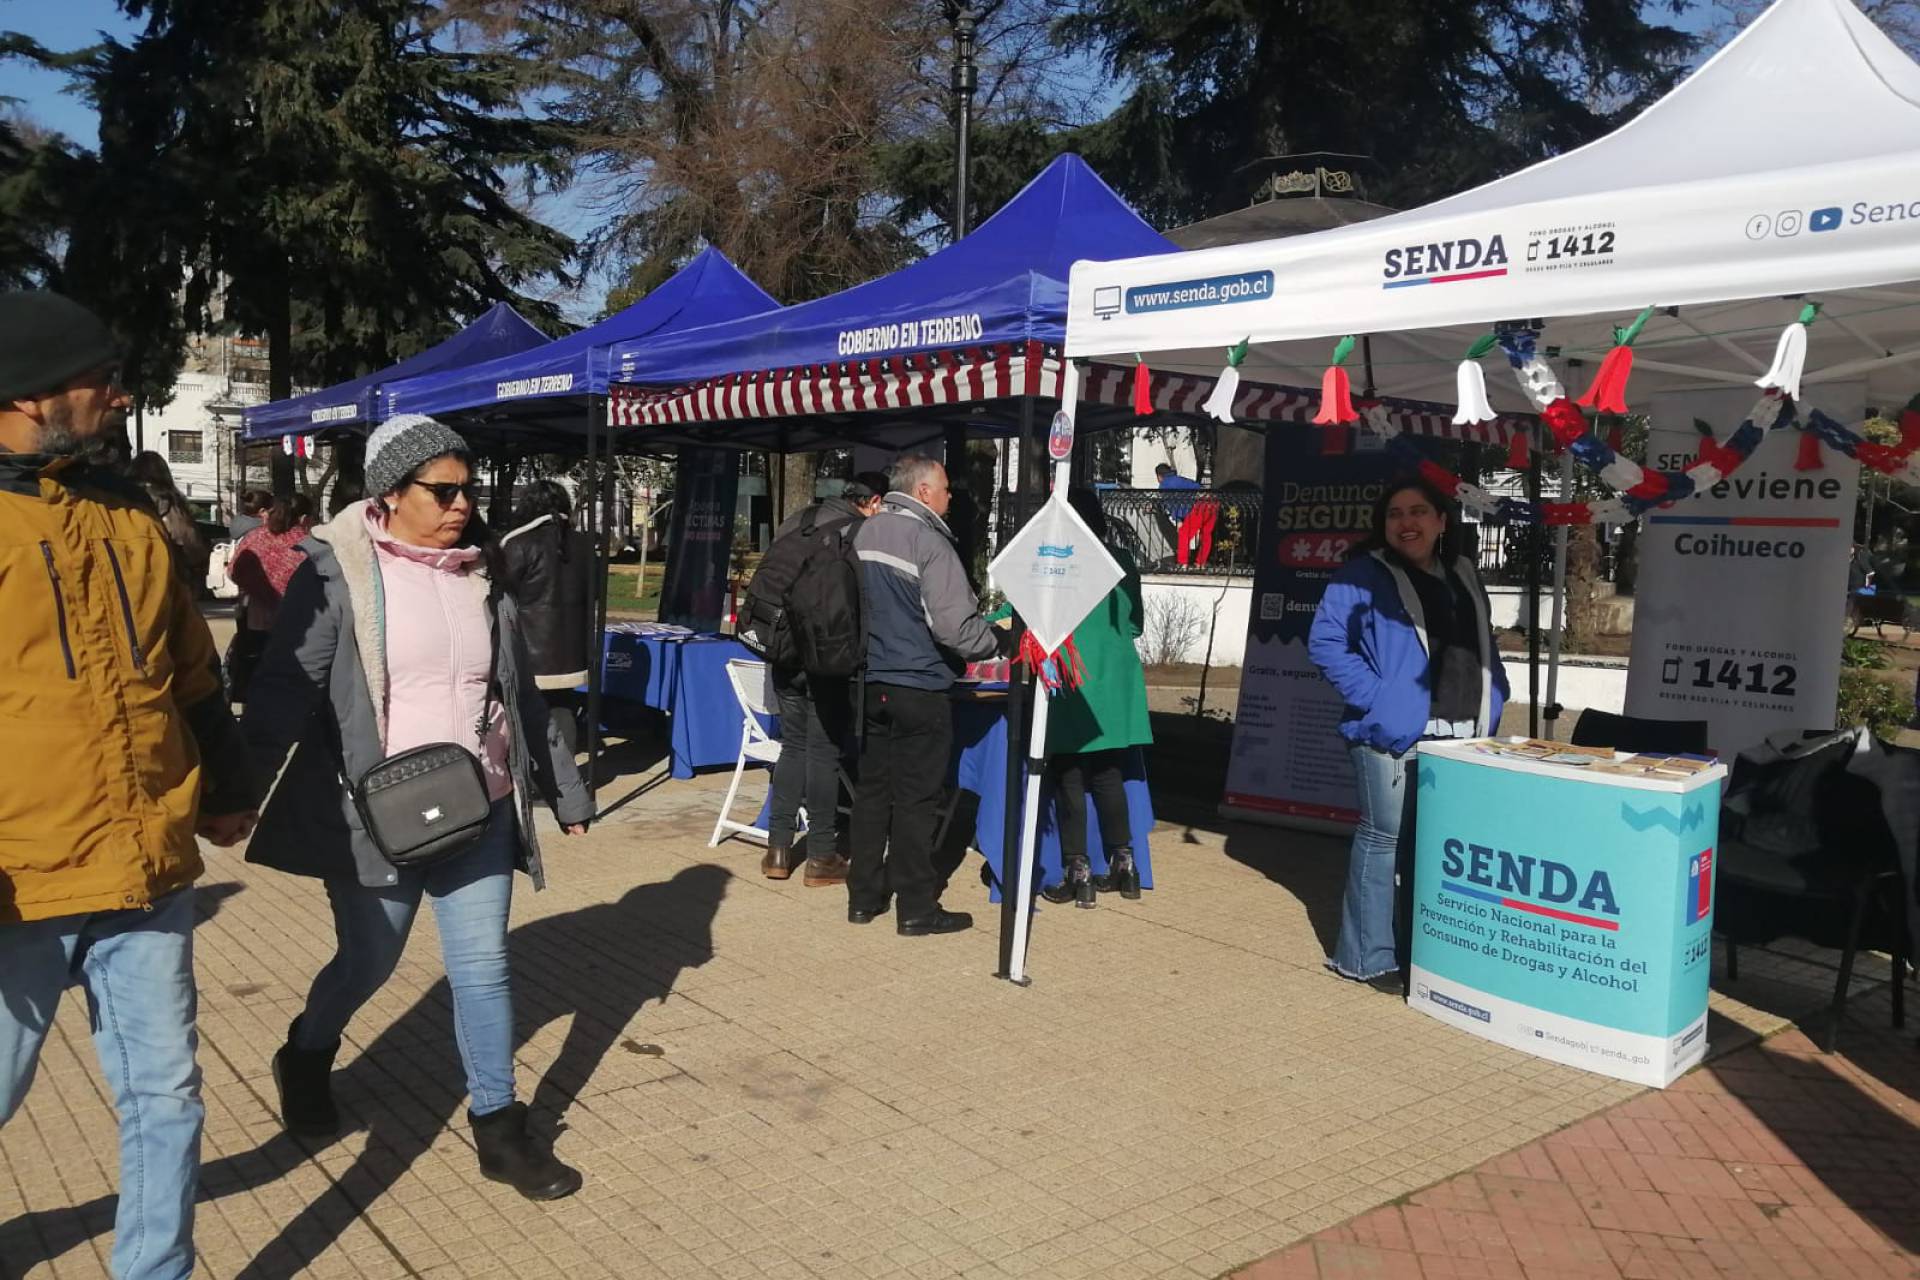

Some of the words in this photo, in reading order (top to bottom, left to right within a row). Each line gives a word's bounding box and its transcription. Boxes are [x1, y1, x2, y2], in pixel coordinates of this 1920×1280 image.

[1383, 234, 1508, 278] SENDA
[1546, 231, 1616, 259] 1412
[1133, 275, 1268, 307] www.senda.gob.cl
[838, 323, 899, 355] GOBIERNO
[900, 321, 919, 348] EN
[921, 313, 983, 345] TERRENO
[1656, 453, 1698, 471] SEN
[1280, 478, 1385, 504] Denunci
[1694, 471, 1842, 500] eviene
[1277, 504, 1375, 529] SEGUR
[1674, 533, 1806, 559] Coihueco
[1665, 642, 1693, 653] FONO
[1695, 645, 1737, 656] DROGAS
[1750, 649, 1798, 661] ALCOHOL
[1691, 658, 1798, 697] 1412
[1441, 838, 1621, 916] SENDA
[1437, 892, 1488, 918] Servicio
[1490, 908, 1556, 937] Nacional
[1560, 928, 1597, 946] para
[1601, 933, 1617, 950] la
[1420, 903, 1486, 937] Prevención
[1488, 928, 1497, 941] y
[1501, 928, 1616, 969] Rehabilitación
[1620, 958, 1648, 975] del
[1422, 922, 1479, 952] Consumo
[1481, 943, 1499, 958] de
[1502, 947, 1555, 973] Drogas
[1558, 966, 1569, 979] y
[1571, 967, 1639, 993] Alcohol
